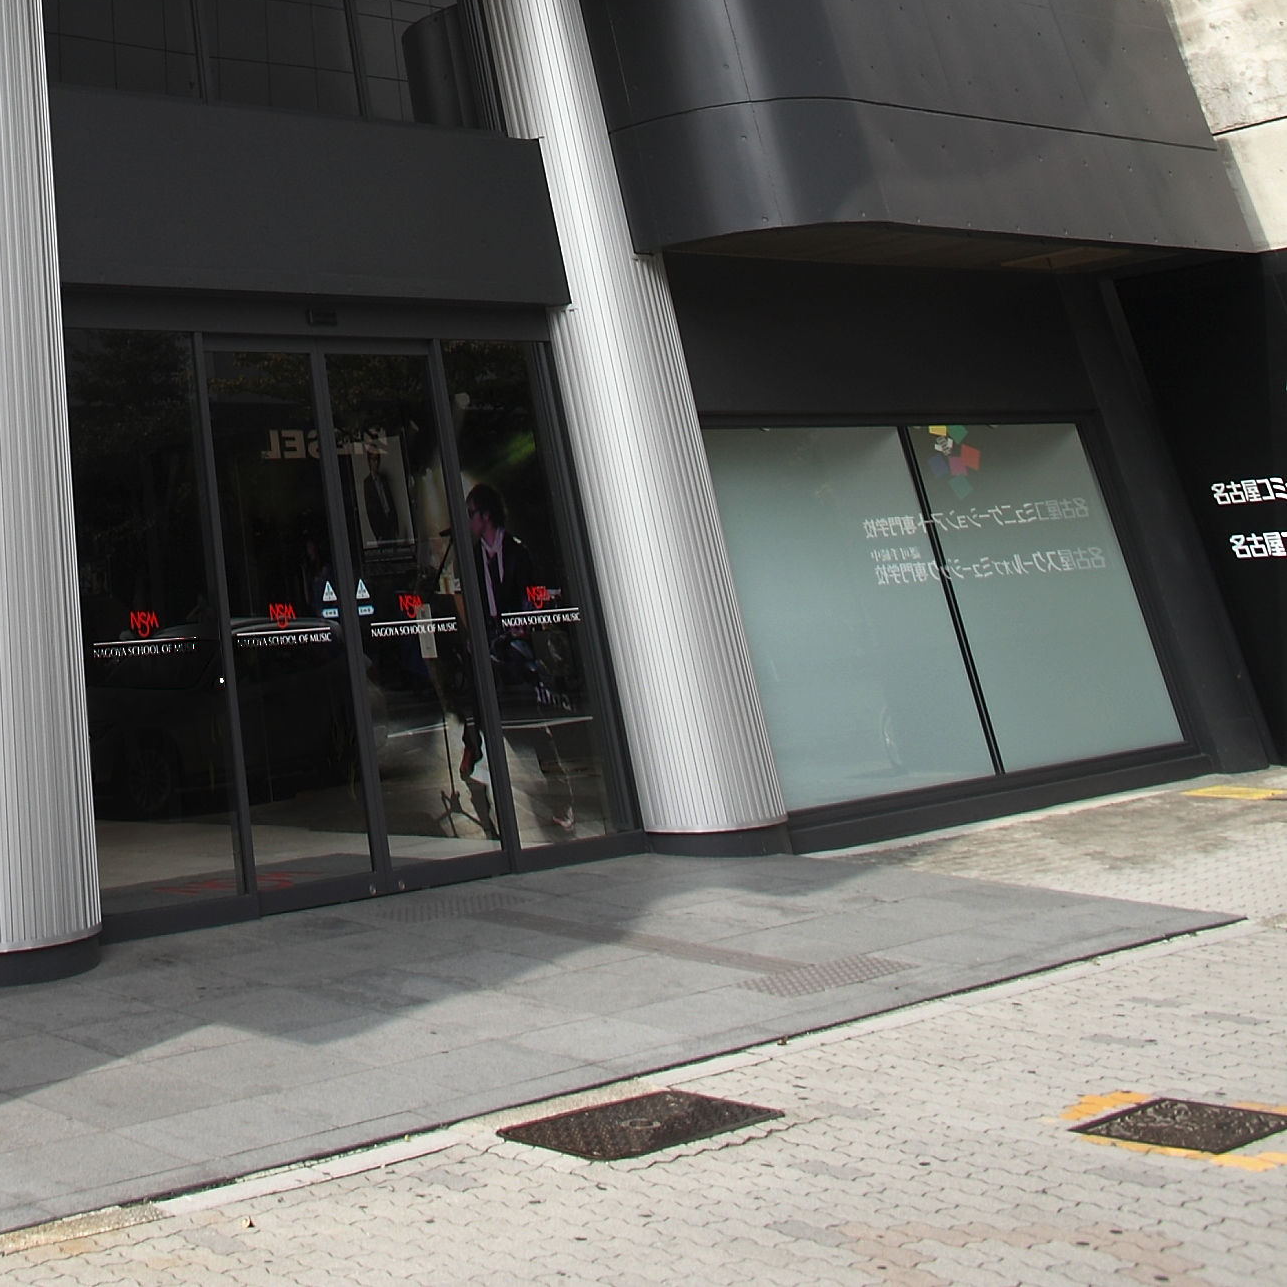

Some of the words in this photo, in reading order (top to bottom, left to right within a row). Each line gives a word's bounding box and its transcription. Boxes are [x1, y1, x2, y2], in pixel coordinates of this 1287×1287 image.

[1211, 477, 1287, 505] 名古屋コミ
[1229, 531, 1287, 559] 名古屋
[129, 610, 160, 638] NSM
[269, 603, 297, 629] NSM
[501, 617, 527, 627] NAGOYA
[528, 615, 552, 625] SCHOOL
[552, 614, 561, 623] OF
[562, 612, 581, 622] MUSIC
[299, 634, 309, 643] OF
[310, 632, 332, 642] MUSIC
[371, 628, 399, 638] NAGOYA
[399, 625, 426, 635] SCHOOL
[427, 625, 436, 633] OF
[437, 622, 458, 632] MUSIC
[93, 647, 127, 658] NAGOYA
[127, 645, 159, 656] SCHOOL
[161, 644, 172, 653] OF
